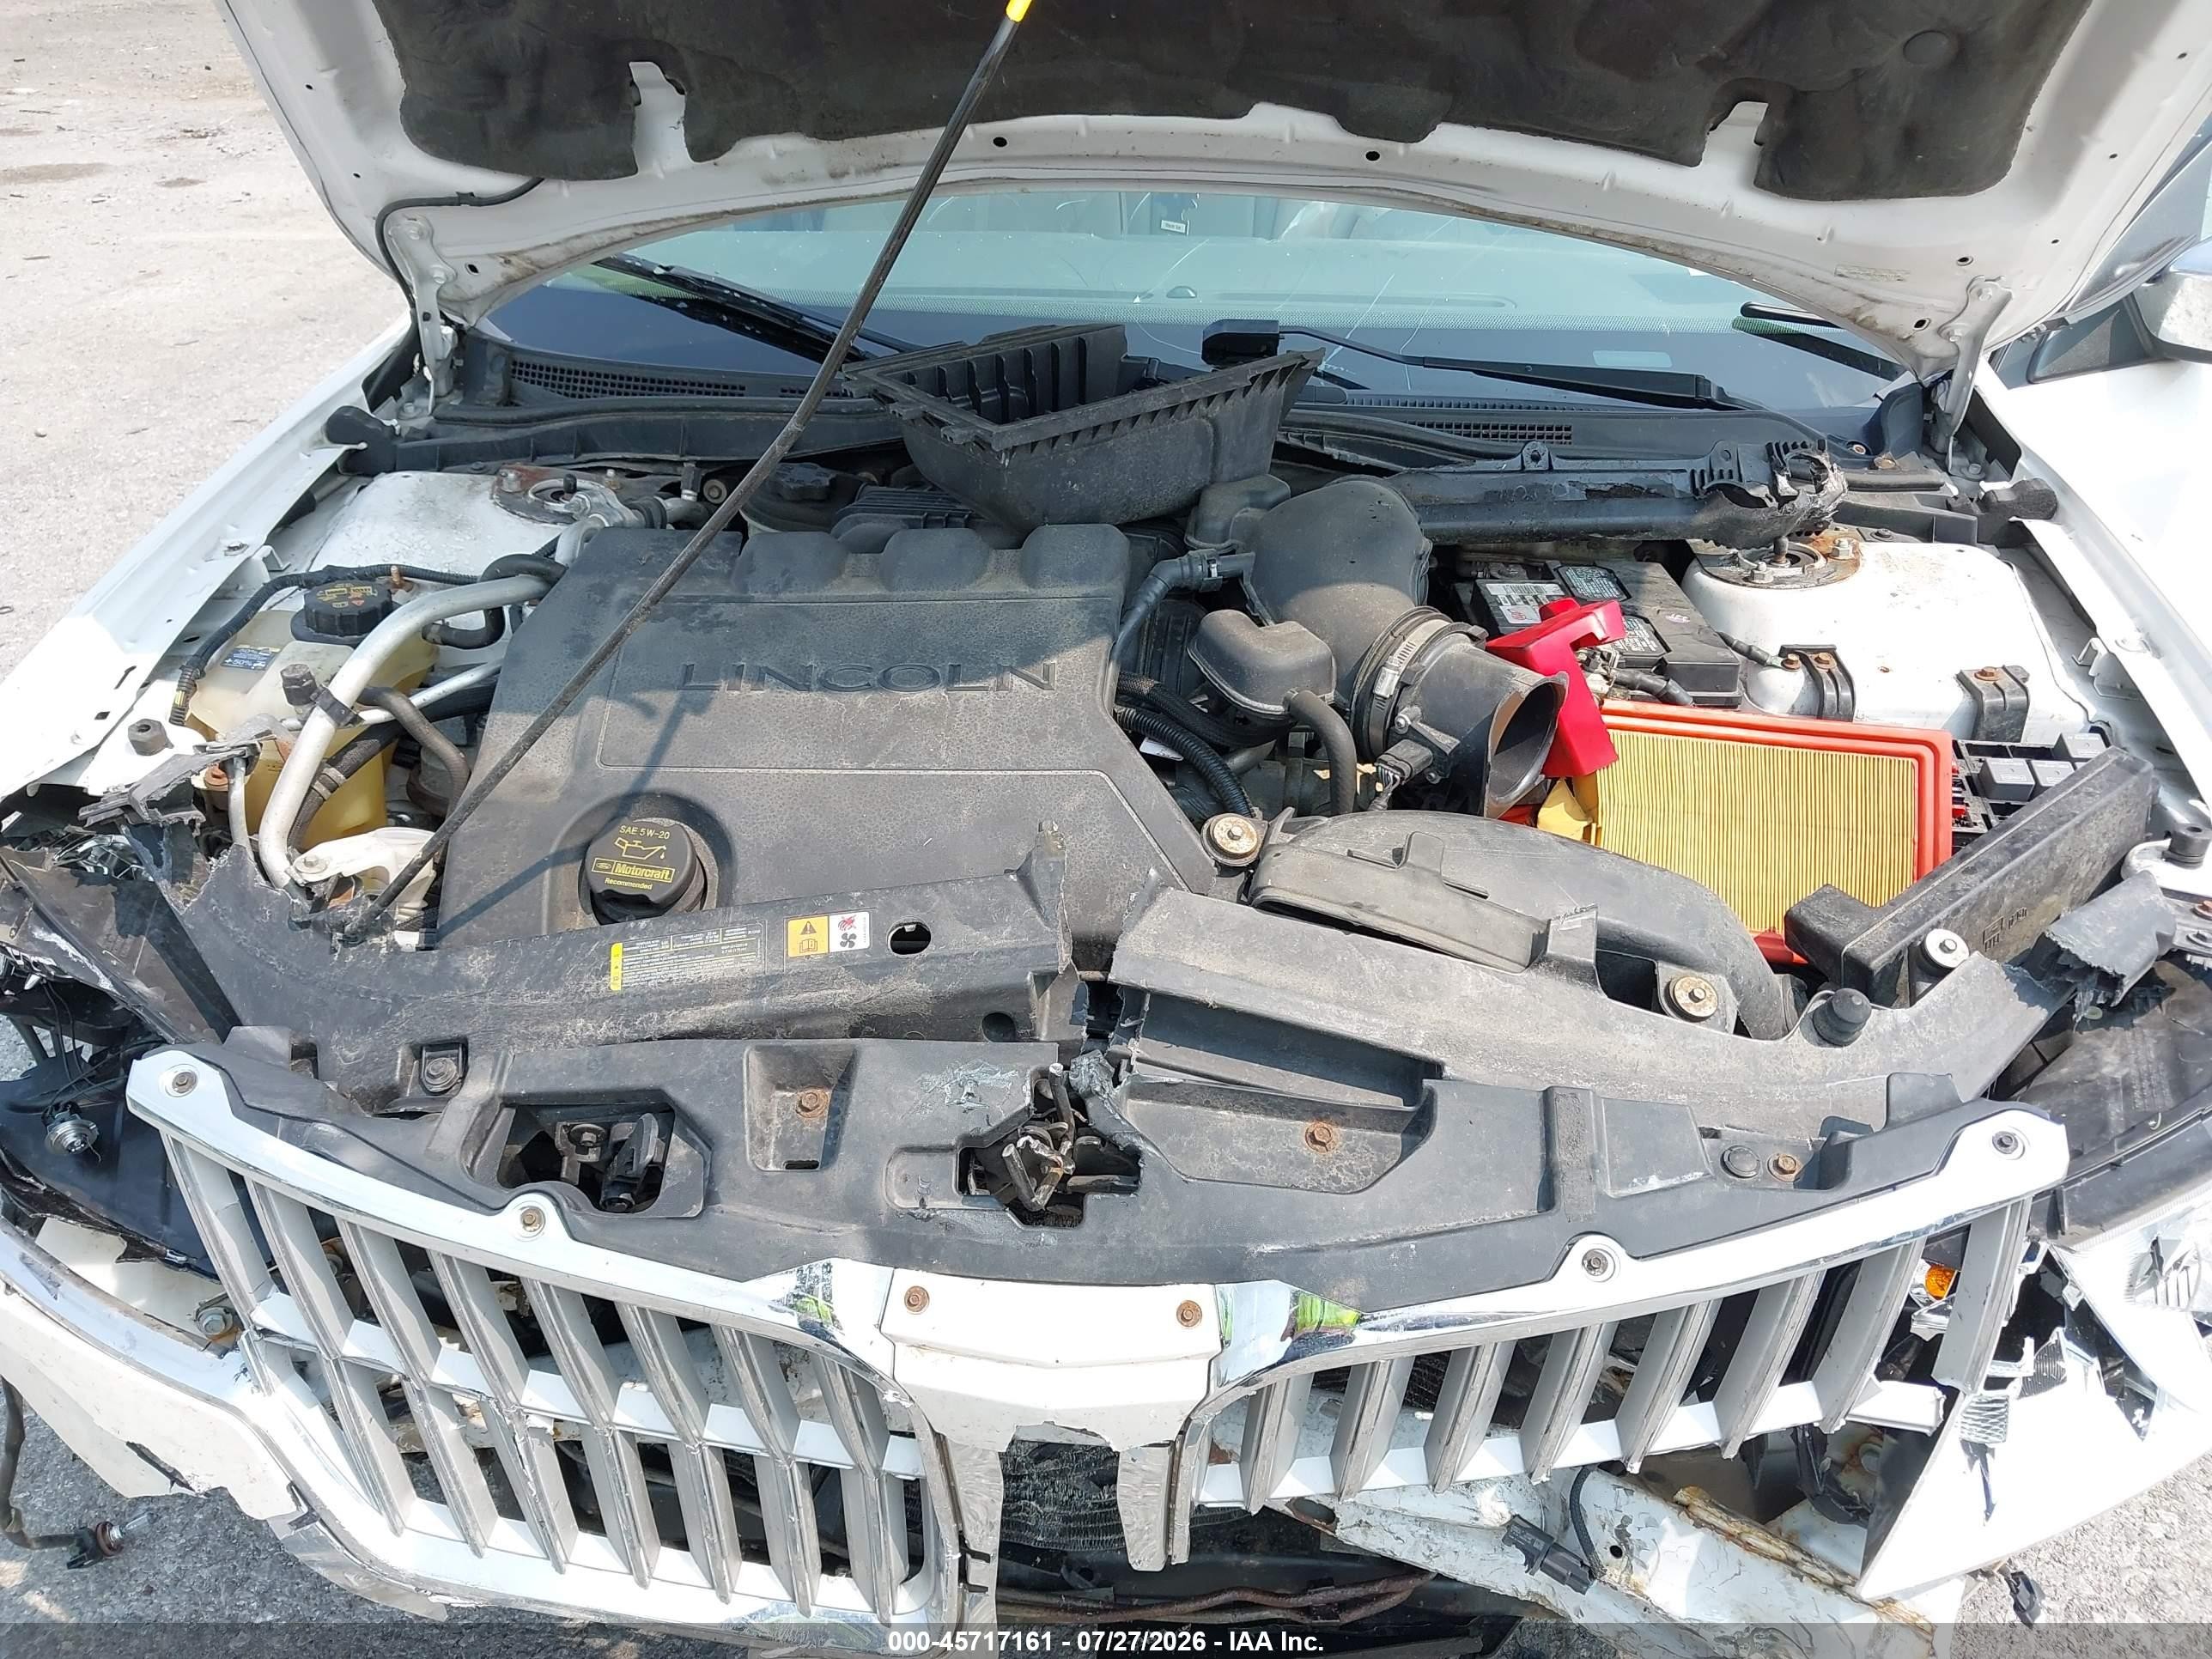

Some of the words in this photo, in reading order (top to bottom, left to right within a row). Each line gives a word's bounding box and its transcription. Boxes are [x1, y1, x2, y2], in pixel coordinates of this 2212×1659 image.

[678, 662, 1057, 693] LINCOLN
[619, 825, 638, 836] SAE
[639, 828, 670, 840] 5W-20
[614, 863, 672, 880] Motorcraft
[605, 878, 653, 890] Recommended
